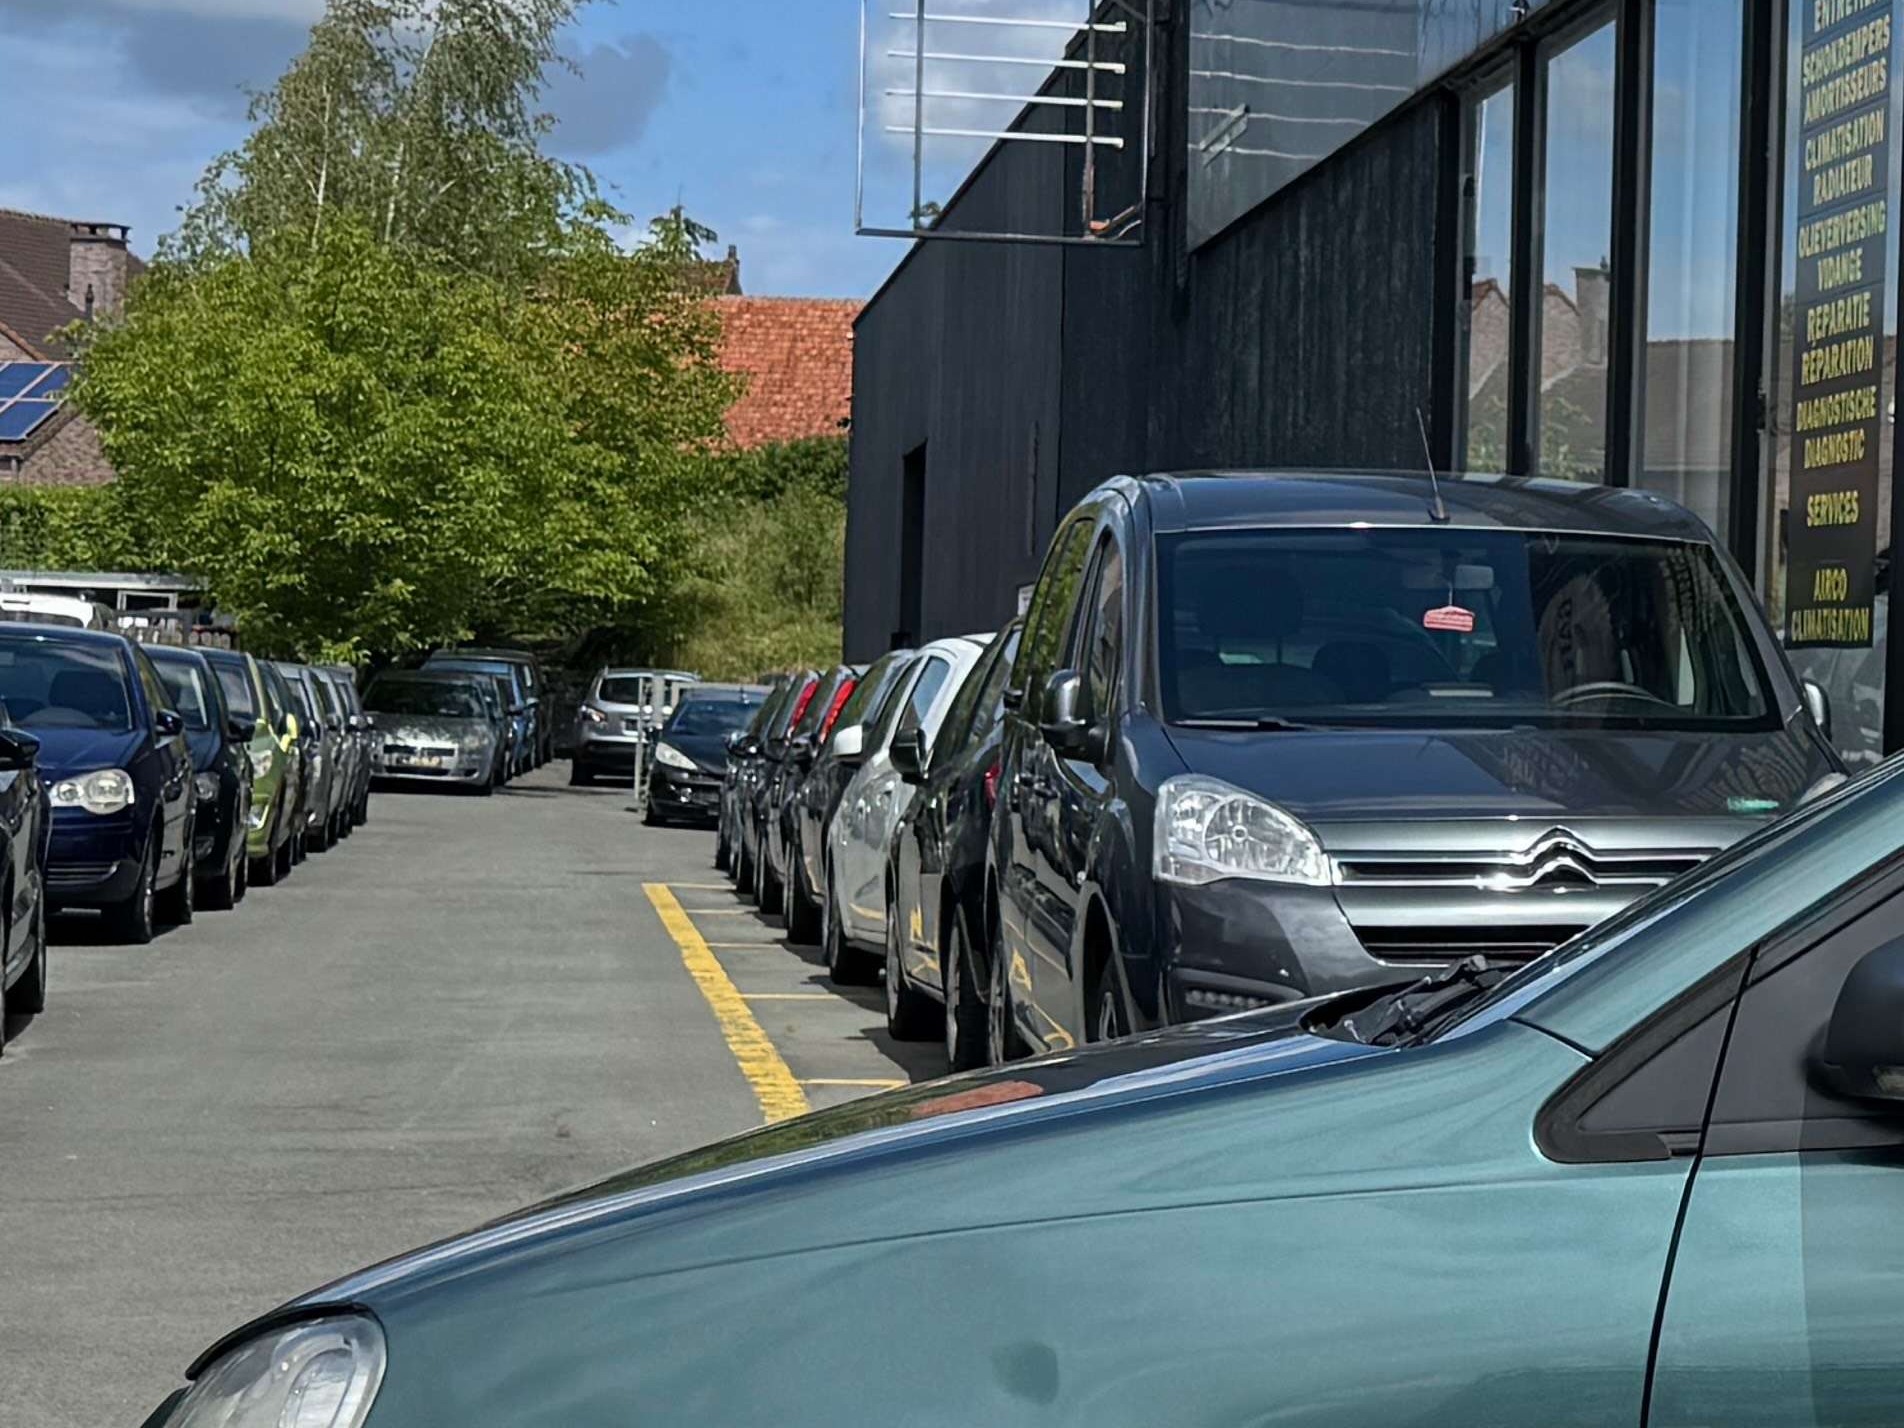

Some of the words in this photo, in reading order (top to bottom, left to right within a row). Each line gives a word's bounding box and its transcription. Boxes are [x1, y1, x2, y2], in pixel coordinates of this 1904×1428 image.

[1803, 13, 1891, 87] SCHOKDEMPERS
[1804, 56, 1887, 125] AMORTISSEURS
[1805, 108, 1885, 172] CLIMATISATION
[1813, 154, 1873, 207] RADIATEUR
[1817, 247, 1864, 293] VIDANGE
[1807, 292, 1872, 344] REPARATIE
[1796, 385, 1877, 433] DIAGNOSTISCHE
[1804, 428, 1865, 469] DIAGNOSTIC
[1806, 490, 1859, 527] SERVICES
[1813, 568, 1848, 602] AIRCO
[1791, 607, 1870, 642] CLIMATISATION
